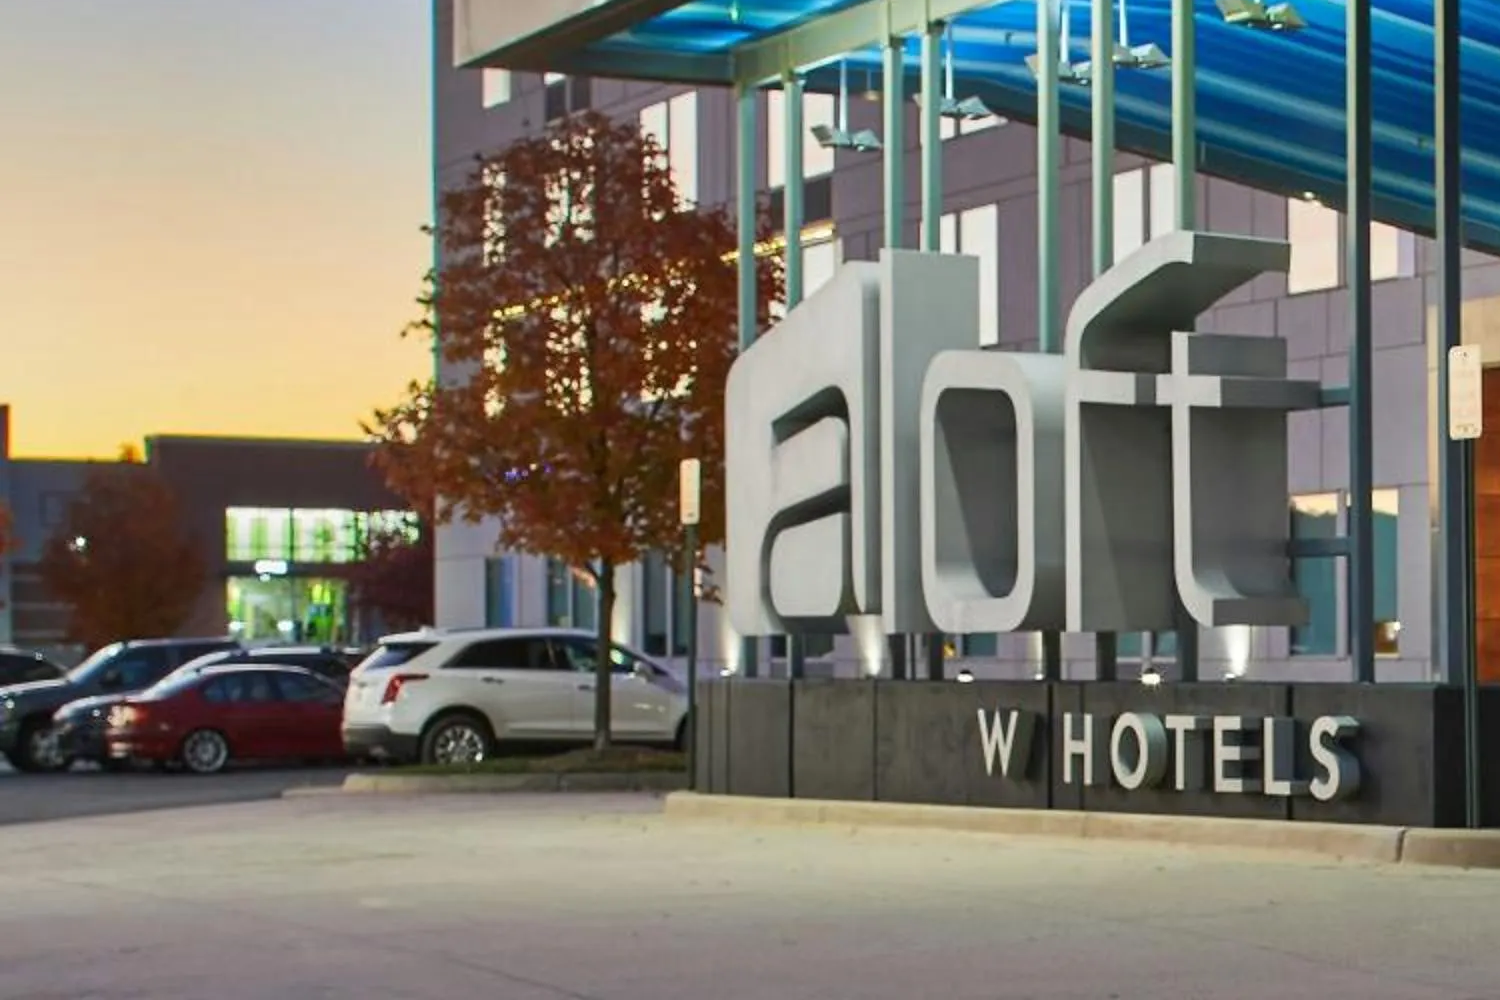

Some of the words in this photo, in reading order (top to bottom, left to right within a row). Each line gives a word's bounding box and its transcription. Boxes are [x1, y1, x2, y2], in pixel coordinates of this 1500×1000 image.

[725, 231, 1300, 636] aloft
[976, 708, 1022, 777] W
[1062, 711, 1352, 801] HOTELS
